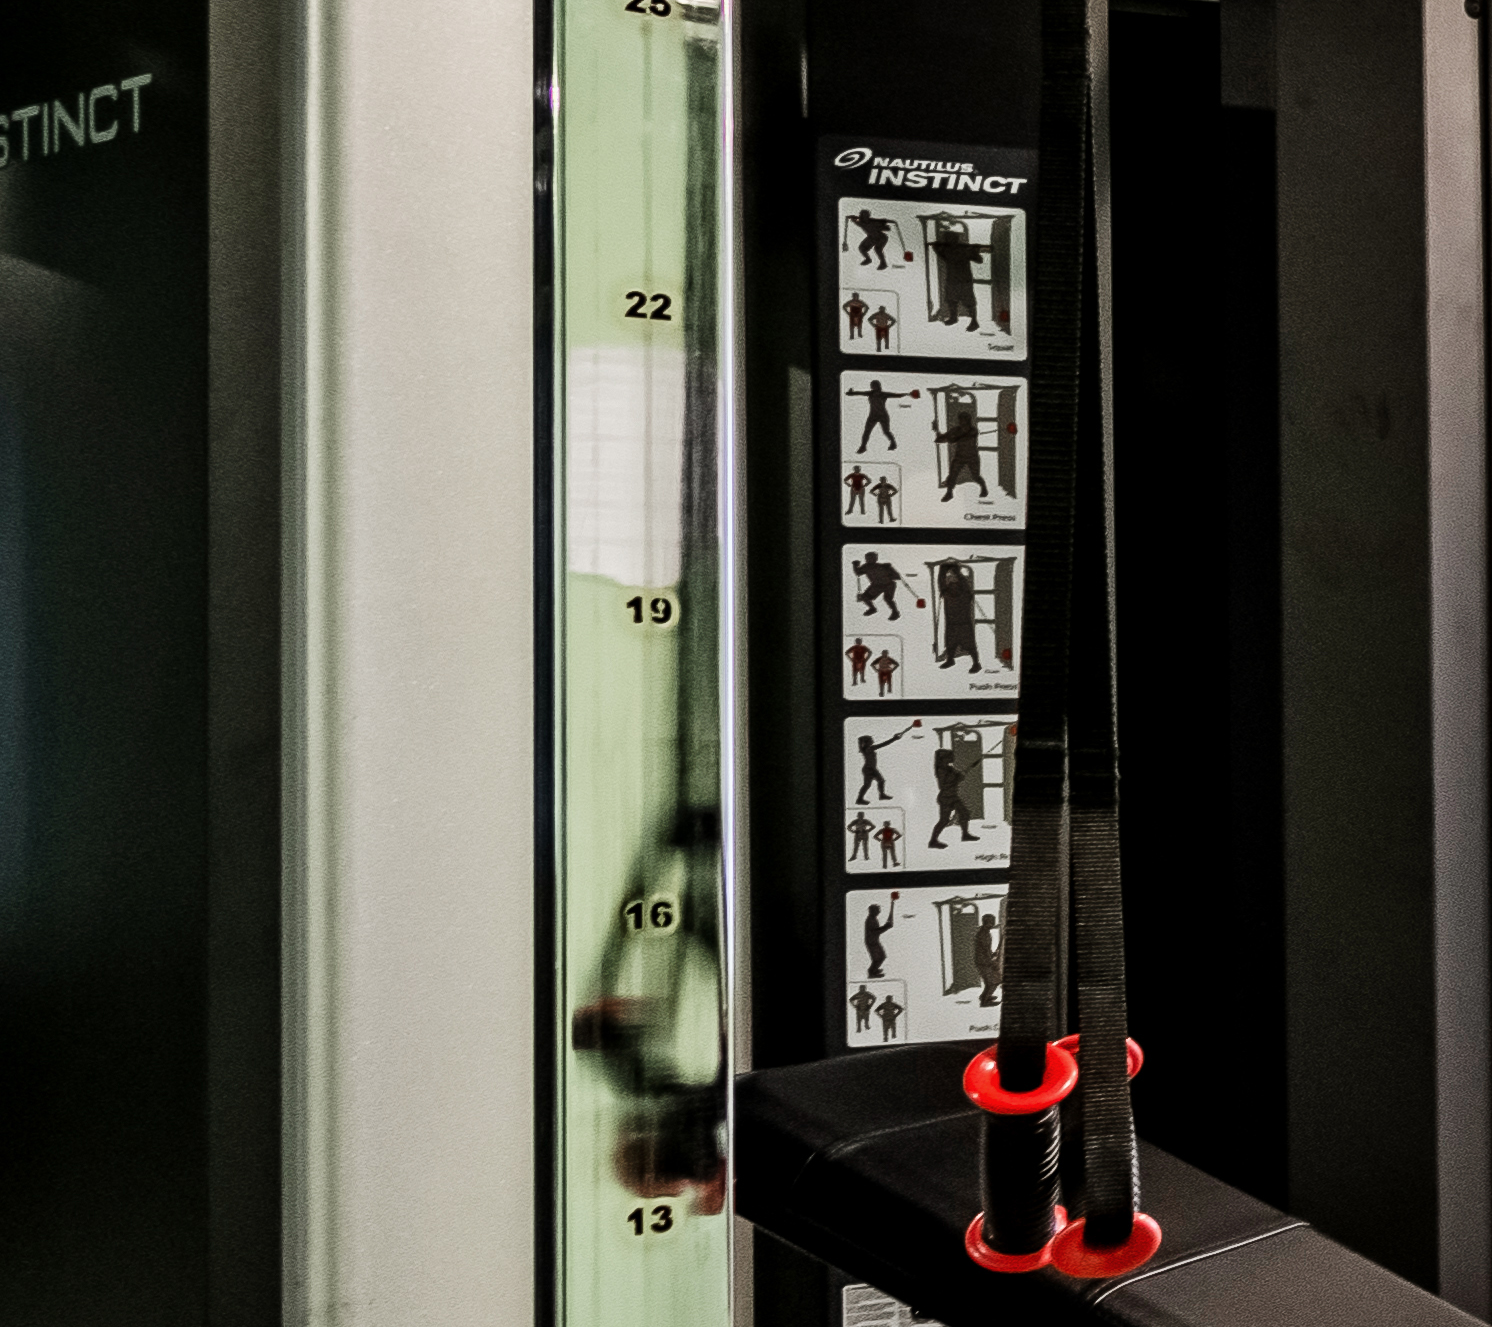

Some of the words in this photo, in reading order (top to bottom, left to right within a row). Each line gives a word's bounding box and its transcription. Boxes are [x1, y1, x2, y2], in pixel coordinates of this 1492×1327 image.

[872, 156, 974, 173] NAUTILUS
[868, 168, 1028, 195] INSTINCT
[624, 291, 672, 321] 22
[626, 596, 672, 624] 19
[626, 900, 673, 930] 16
[627, 1204, 673, 1236] 13
